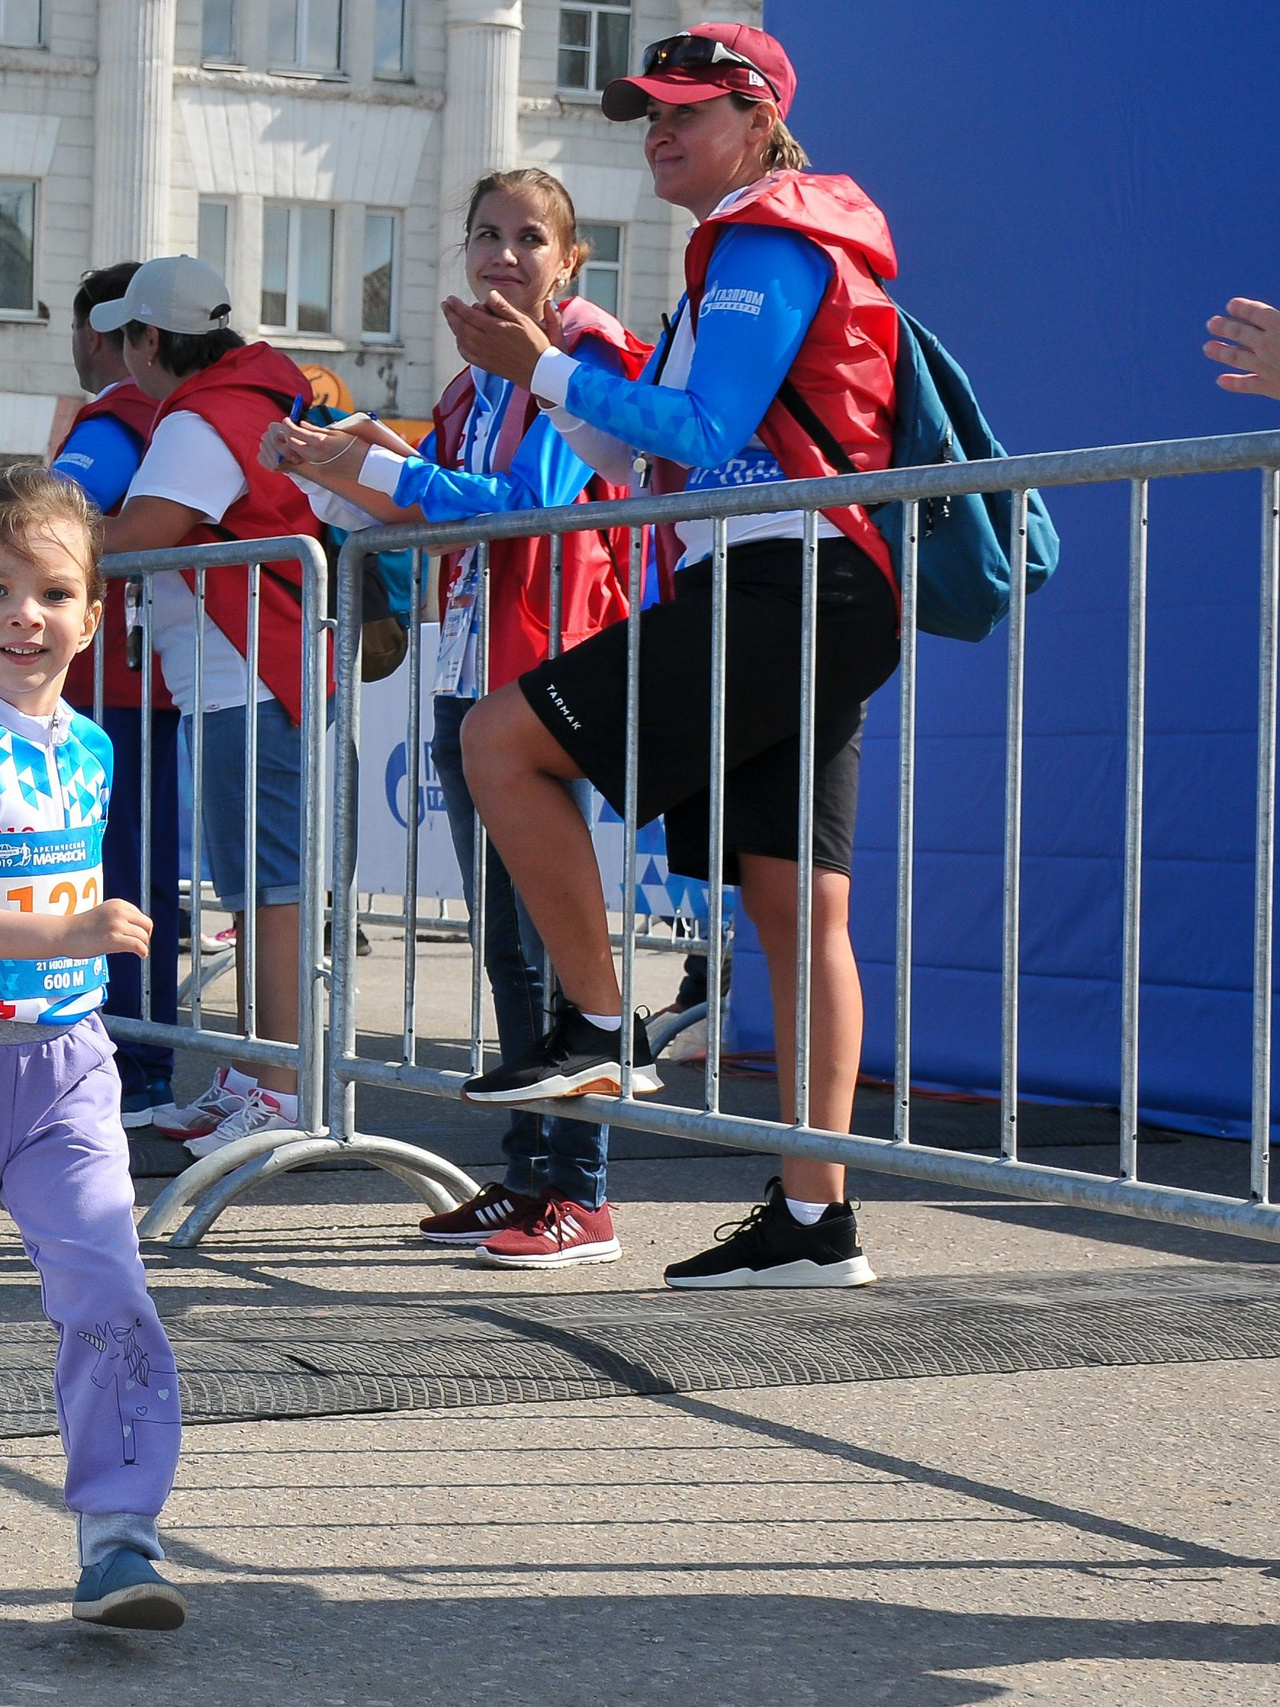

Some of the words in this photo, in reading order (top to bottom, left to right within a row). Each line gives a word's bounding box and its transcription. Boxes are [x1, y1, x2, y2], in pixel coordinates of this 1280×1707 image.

[714, 288, 765, 306] ГАЗПРОМ
[546, 683, 583, 731] TARMAK
[33, 840, 86, 853] АРКТИЧЕСКИЙ
[32, 849, 87, 866] МАРАФОН
[36, 961, 47, 971] 21
[43, 972, 71, 990] 600
[72, 970, 84, 987] М
